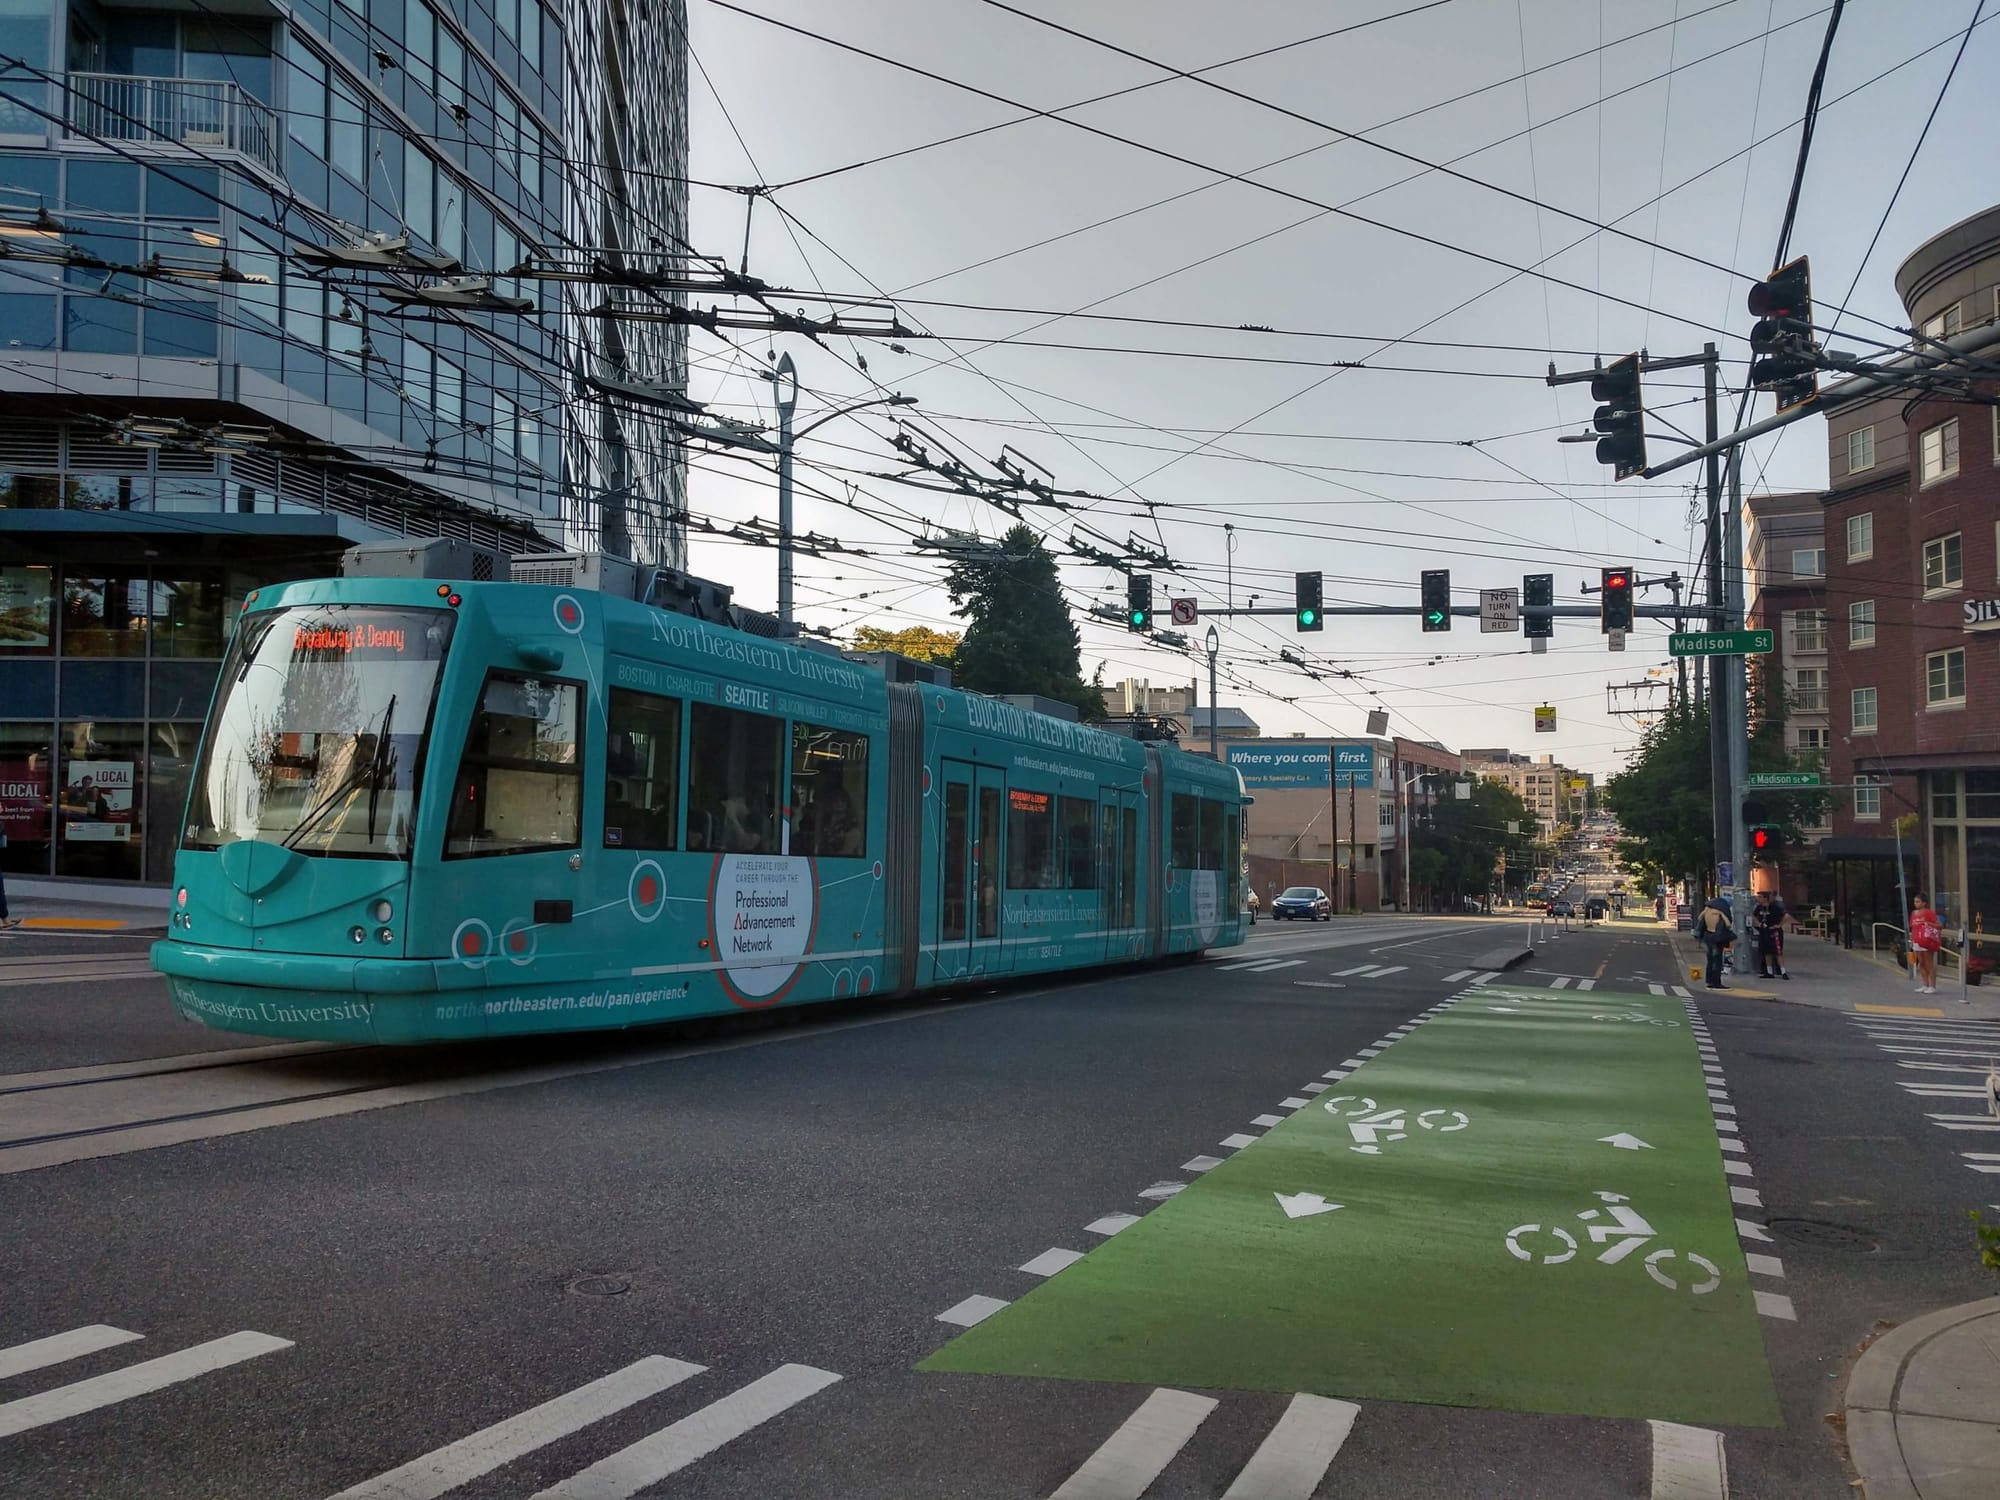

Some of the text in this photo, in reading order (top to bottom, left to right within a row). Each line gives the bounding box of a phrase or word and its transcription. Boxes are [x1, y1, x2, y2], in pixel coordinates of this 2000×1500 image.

[1490, 591, 1508, 601] NO
[1488, 602, 1511, 611] TURN
[1493, 611, 1506, 620] ON
[1491, 621, 1509, 630] RED
[355, 625, 365, 648] &
[367, 625, 404, 653] Denny
[1674, 637, 1768, 651] Madison St
[649, 611, 865, 699] Northeastern University
[618, 664, 656, 686] BOSTON
[666, 674, 714, 699] CHARLOTTE
[725, 685, 769, 711] SEATTLE
[965, 695, 1026, 739] EDUCATION
[1026, 711, 1063, 747] FUELED
[1064, 721, 1077, 751] BY
[1231, 752, 1272, 763] Where
[1274, 754, 1298, 766] you
[1338, 751, 1368, 763] first.
[96, 770, 129, 783] LOCAL
[1757, 775, 1792, 785] Madison
[1, 783, 41, 798] LOCAL
[735, 890, 789, 908] Professional
[734, 912, 796, 930] Advancement
[733, 934, 773, 953] Network
[258, 1000, 375, 1024] University
